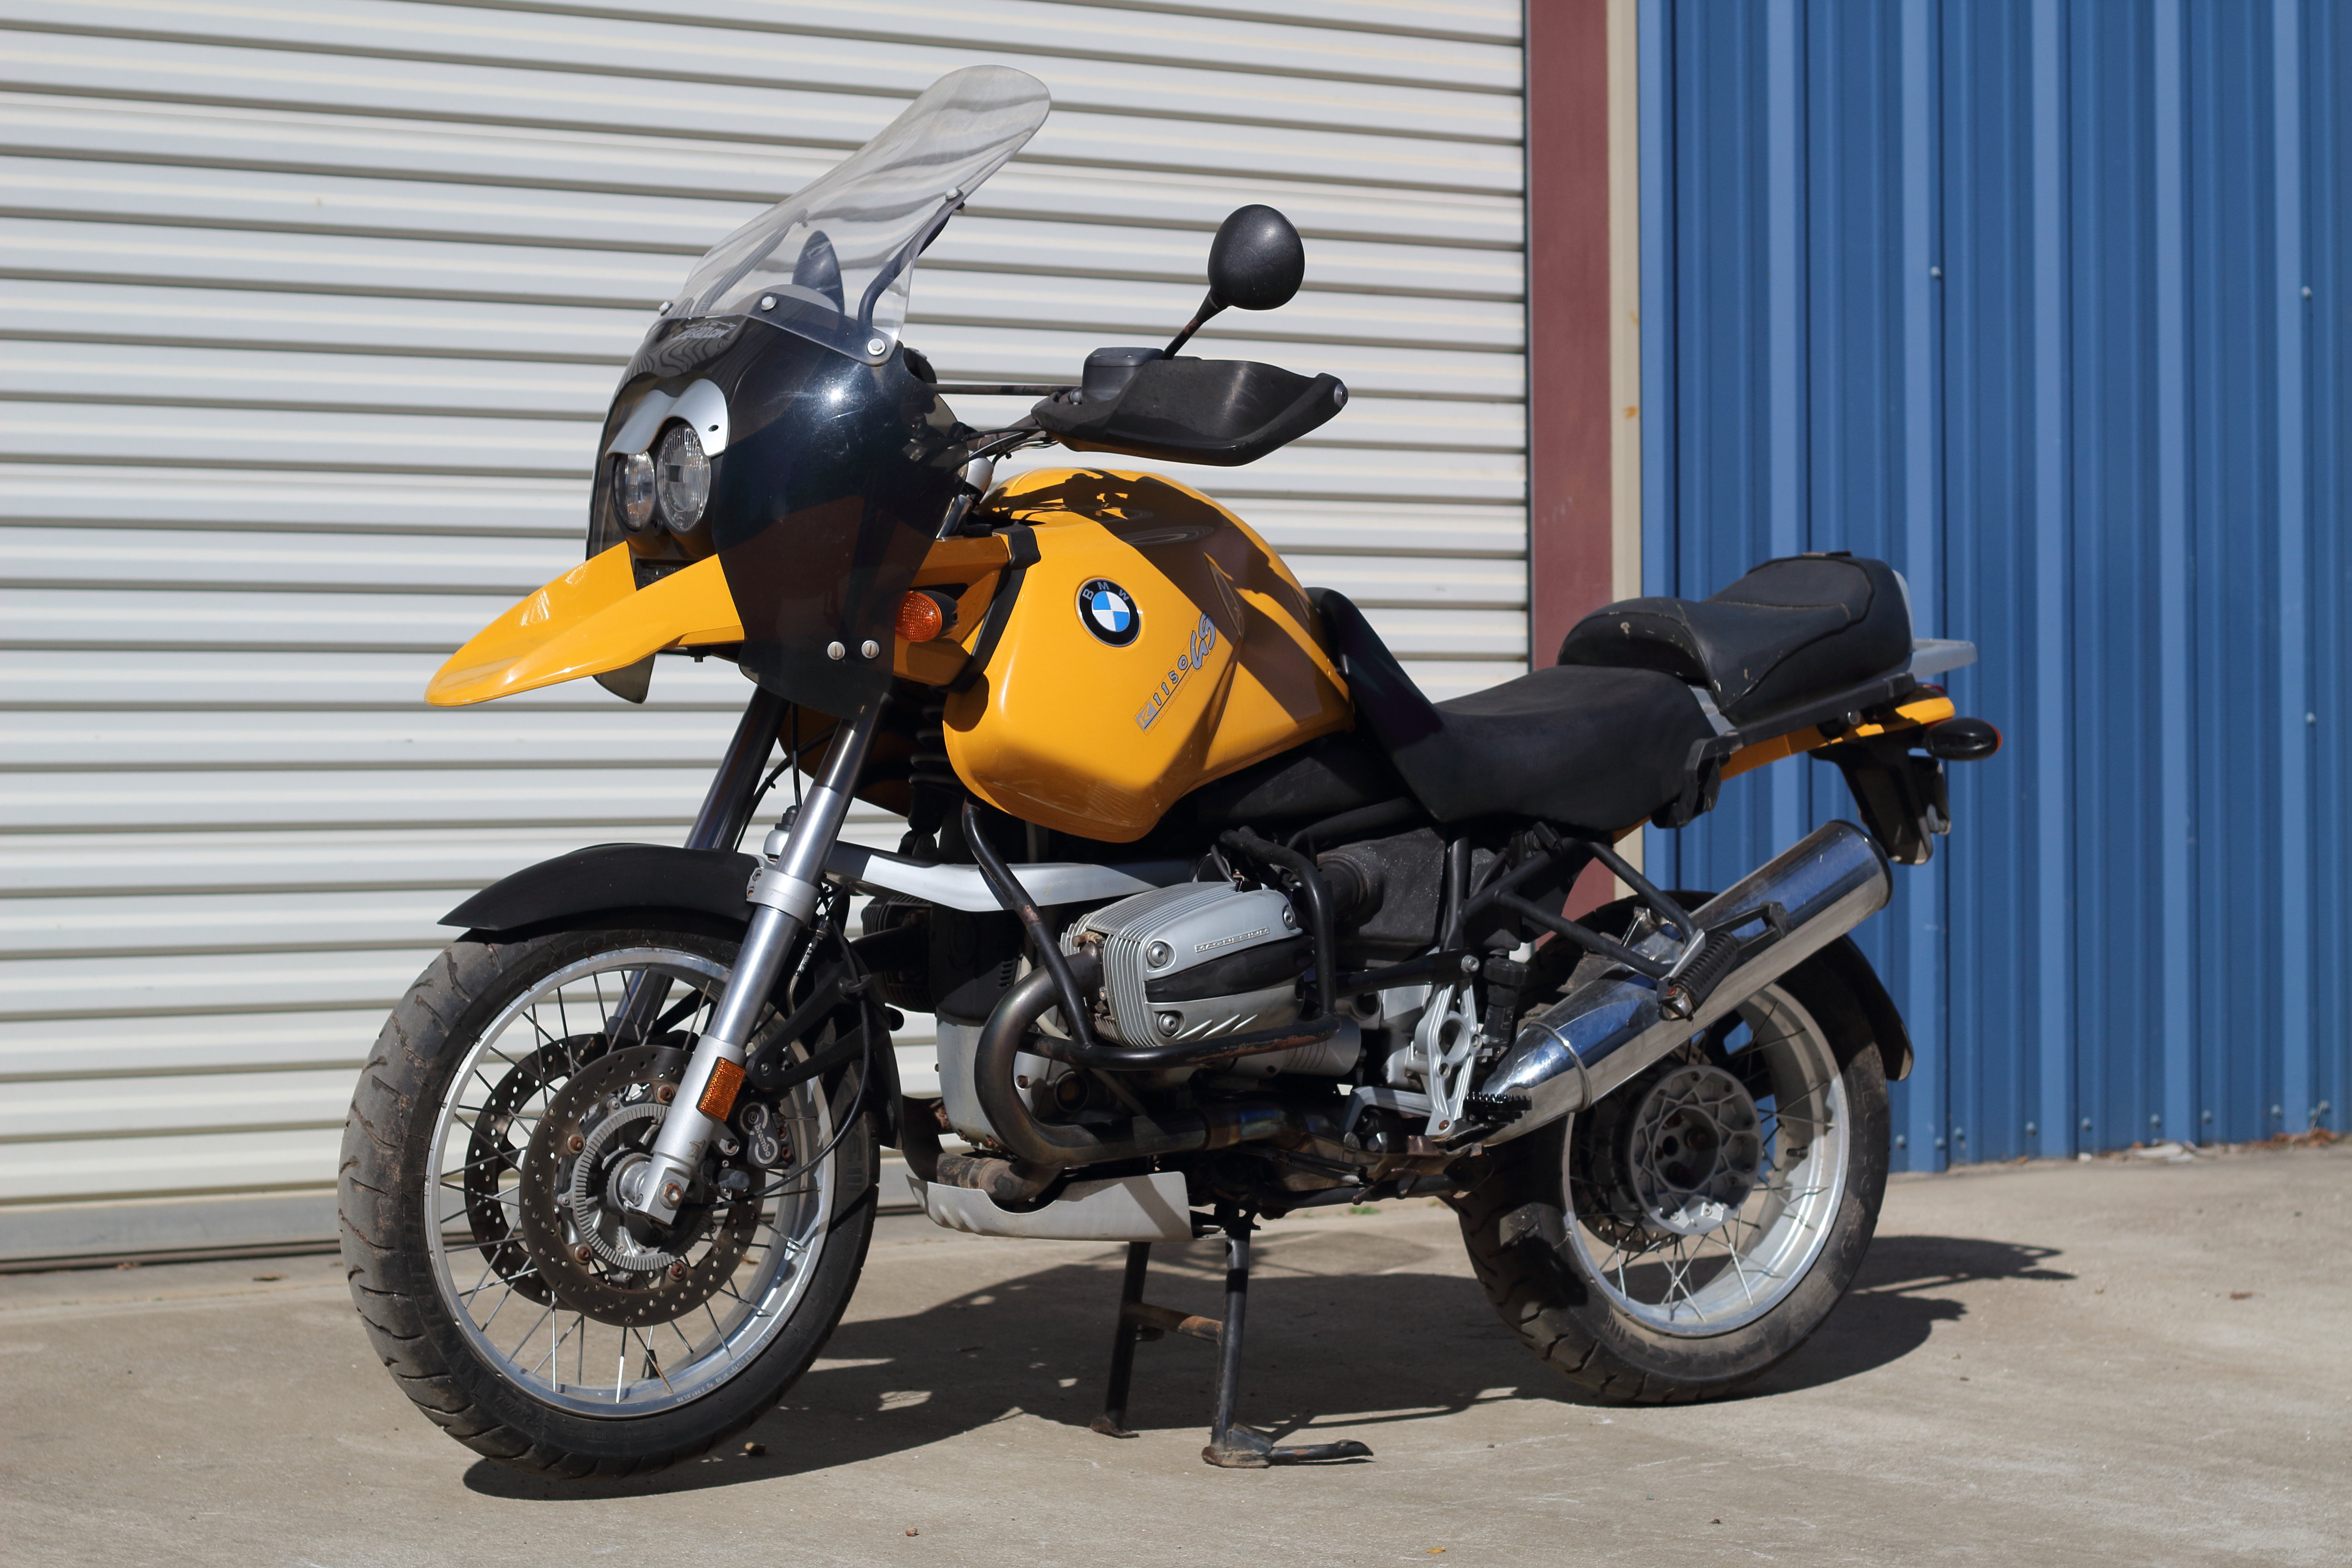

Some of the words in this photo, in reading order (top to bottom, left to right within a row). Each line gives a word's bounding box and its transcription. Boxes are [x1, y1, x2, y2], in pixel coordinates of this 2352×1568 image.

[1082, 581, 1129, 601] BMW
[1152, 654, 1188, 706] 1150
[1190, 611, 1216, 670] GS
[1196, 928, 1269, 952] MAGNESIUM
[754, 1123, 770, 1157] brembo
